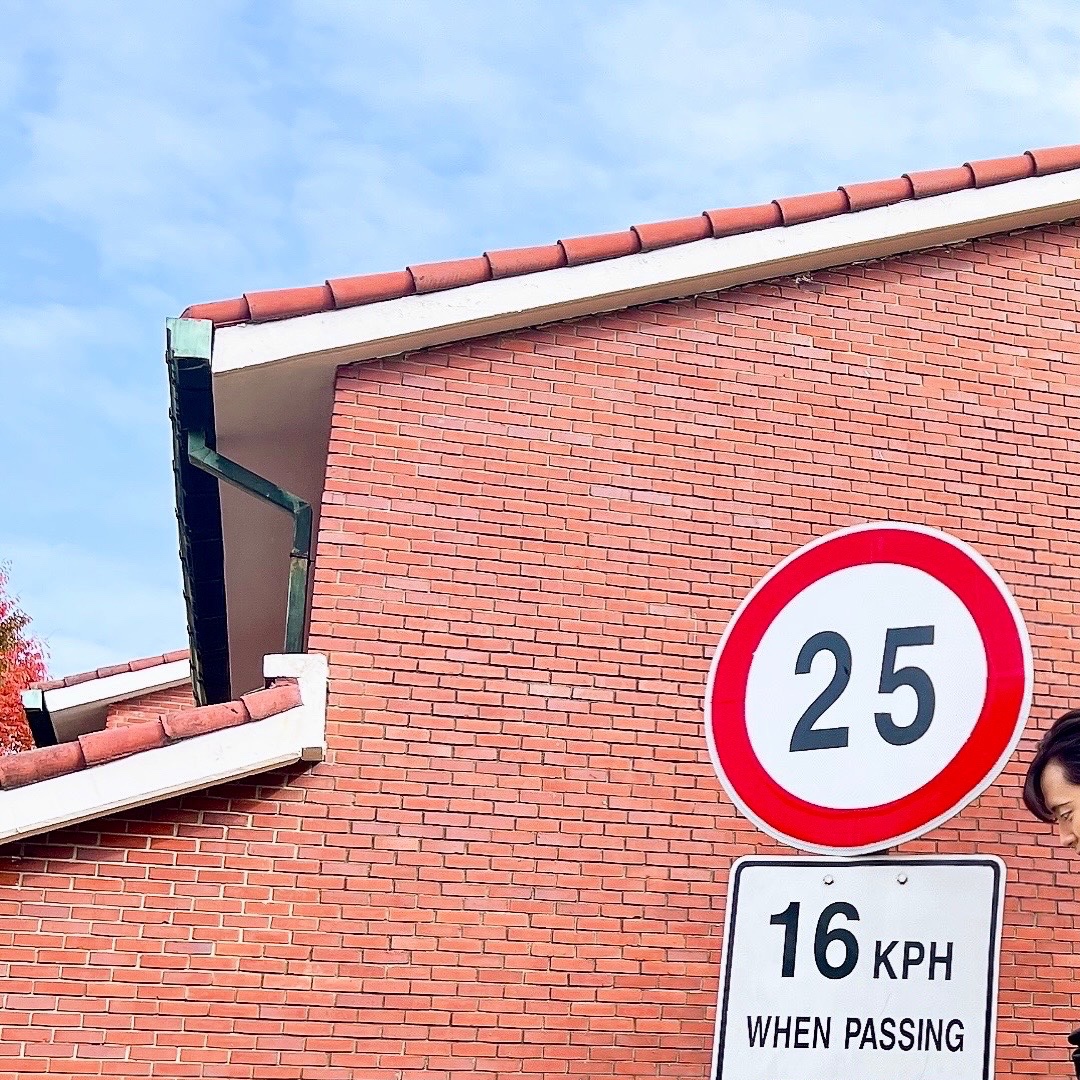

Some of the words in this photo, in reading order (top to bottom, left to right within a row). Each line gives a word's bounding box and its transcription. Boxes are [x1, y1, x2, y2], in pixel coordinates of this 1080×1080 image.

[789, 625, 936, 752] 25
[769, 901, 861, 979] 16
[872, 940, 954, 981] KPH
[746, 1015, 832, 1049] WHEN
[844, 1017, 965, 1052] PASSING
